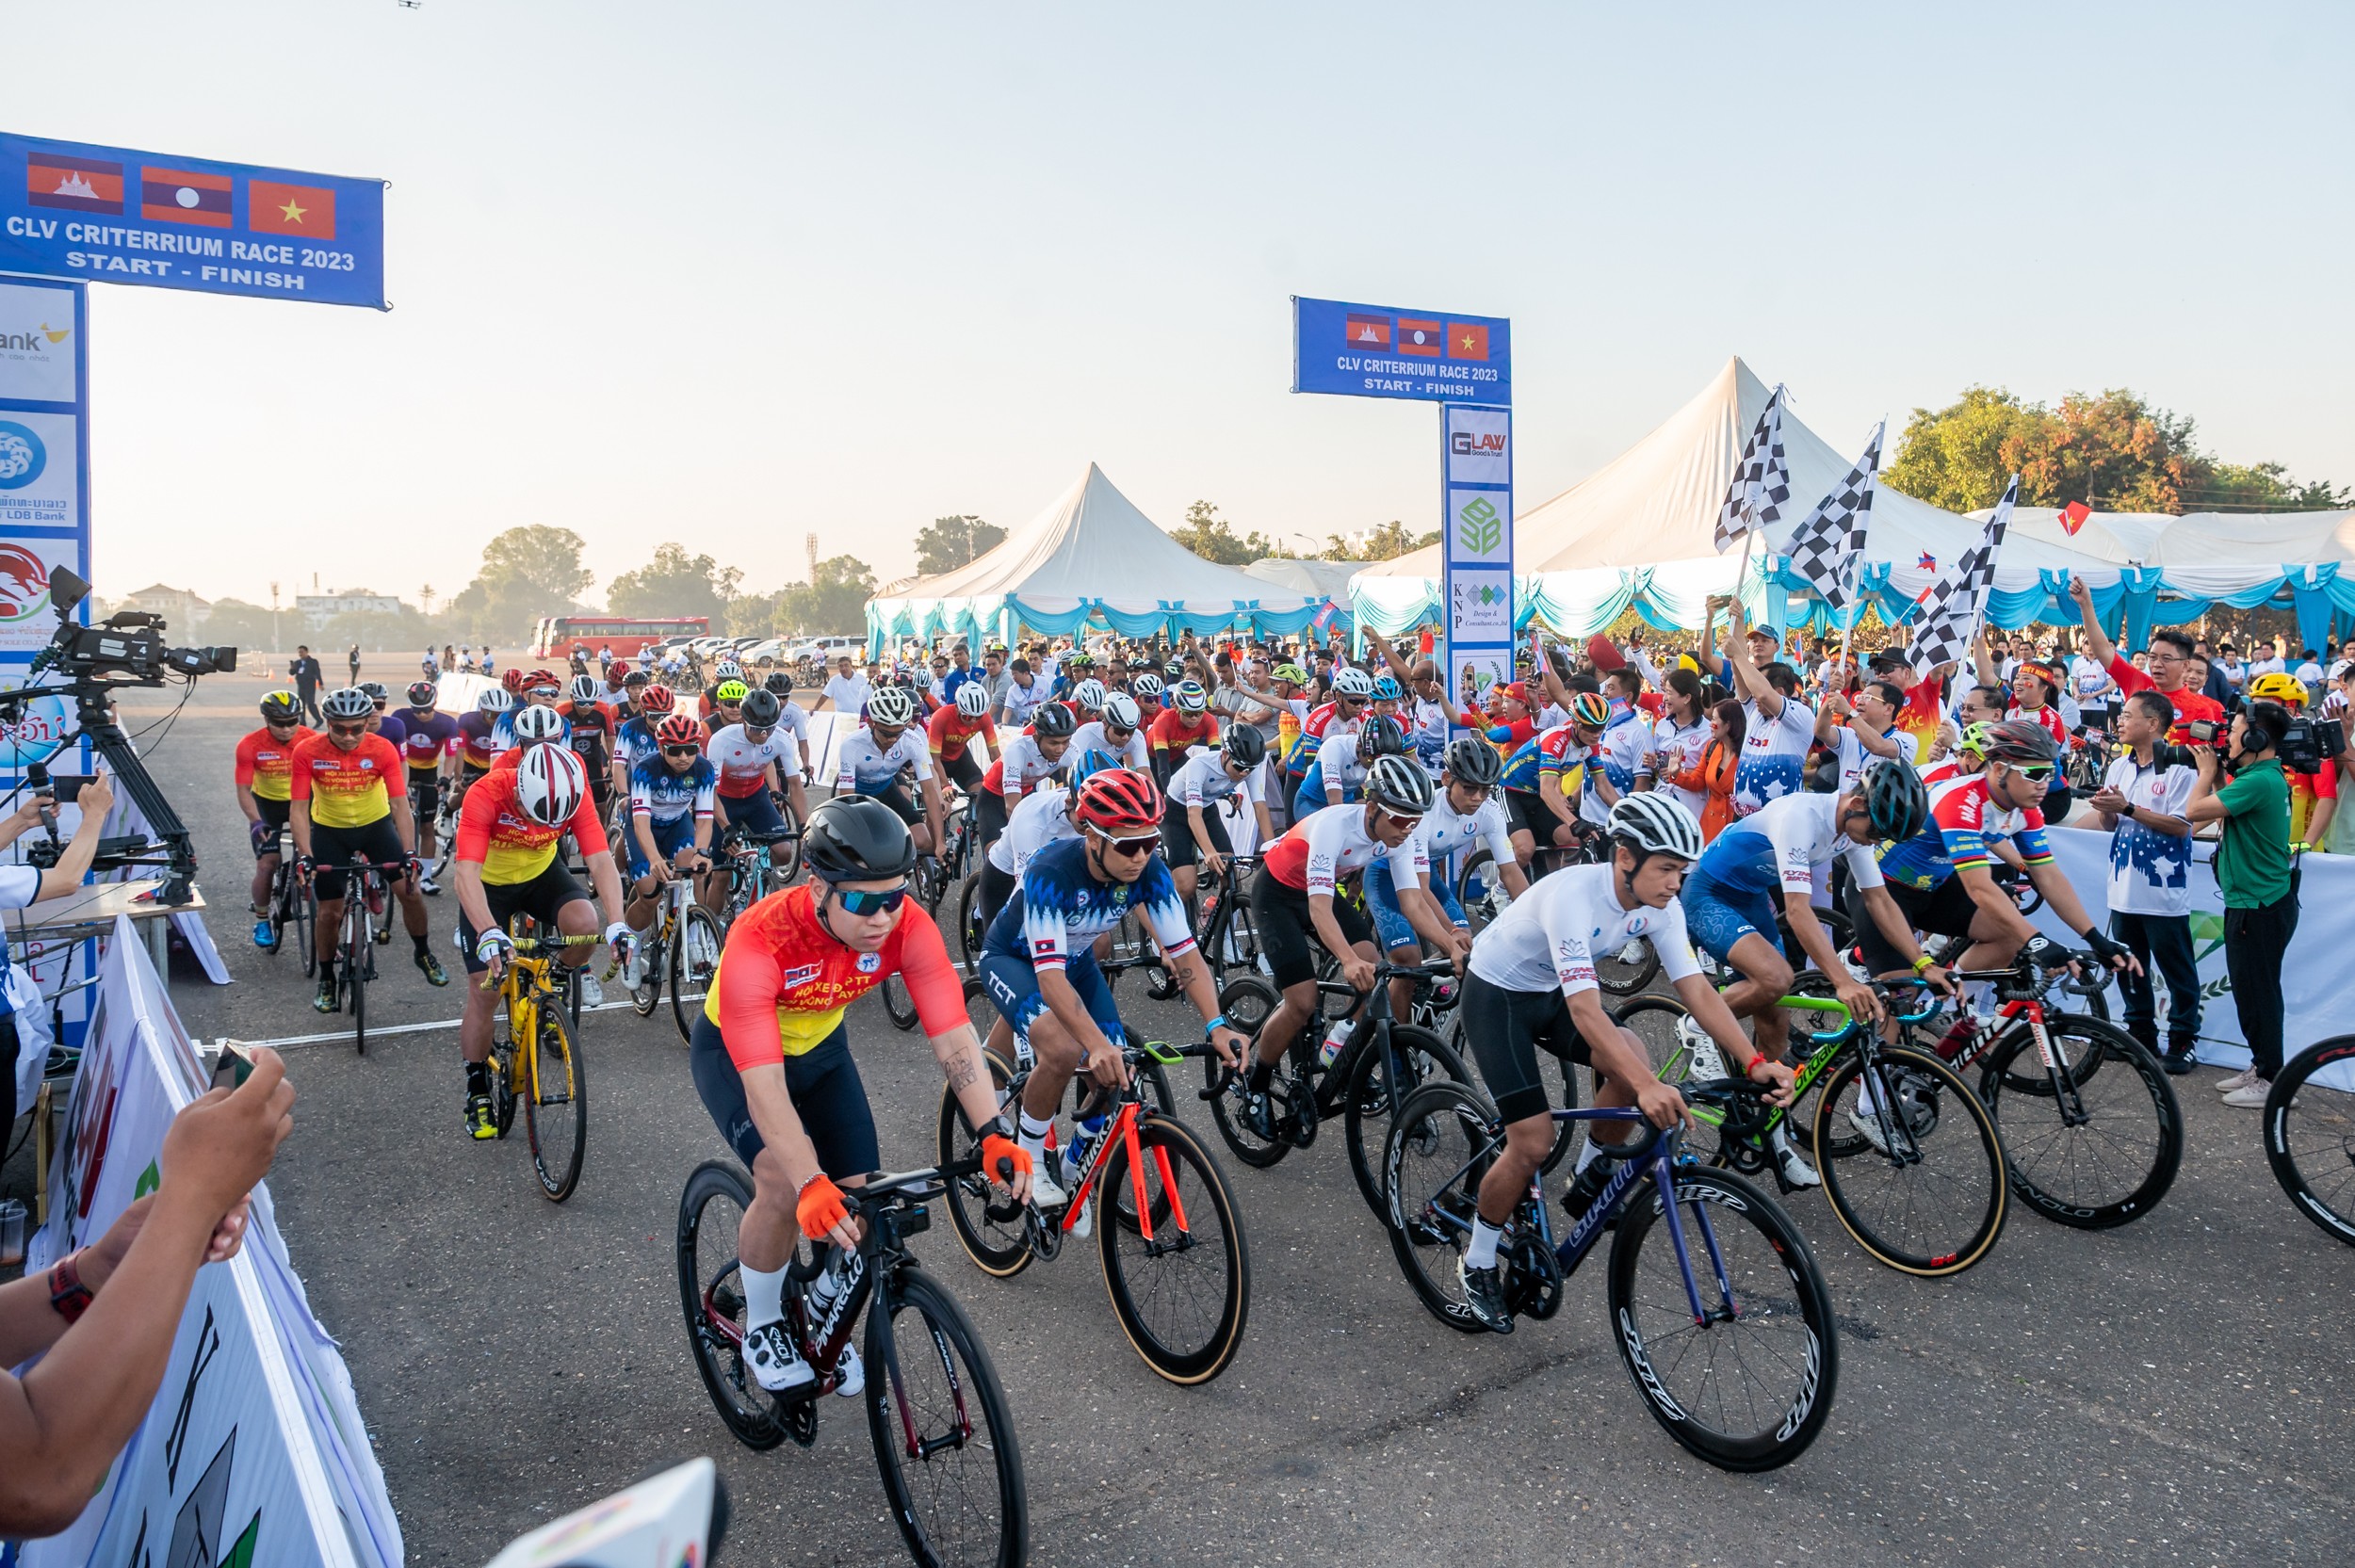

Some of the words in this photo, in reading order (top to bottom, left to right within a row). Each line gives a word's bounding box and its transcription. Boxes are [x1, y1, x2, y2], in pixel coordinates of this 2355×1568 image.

[7, 216, 57, 239] CLV
[65, 222, 222, 257] CRITERRIUM
[231, 240, 294, 265] RACE
[300, 249, 355, 271] 2023
[66, 251, 172, 276] START
[201, 265, 304, 290] FINISH
[1338, 356, 1360, 371] CLV
[1364, 359, 1437, 377] CRITERRIUM
[1439, 364, 1469, 380] RACE
[1471, 367, 1498, 381] 2023
[1364, 378, 1412, 393] START
[1425, 382, 1474, 396] FINISH
[7, 510, 31, 520] LDB
[35, 511, 65, 521] Bank
[139, 646, 147, 655] 4
[988, 970, 1016, 1005] TCT
[1595, 974, 1632, 988] DURA-AC
[2031, 1024, 2052, 1065] Sunweb
[815, 1253, 864, 1358] PINARELLO
[934, 1331, 957, 1390] PINARELLO
